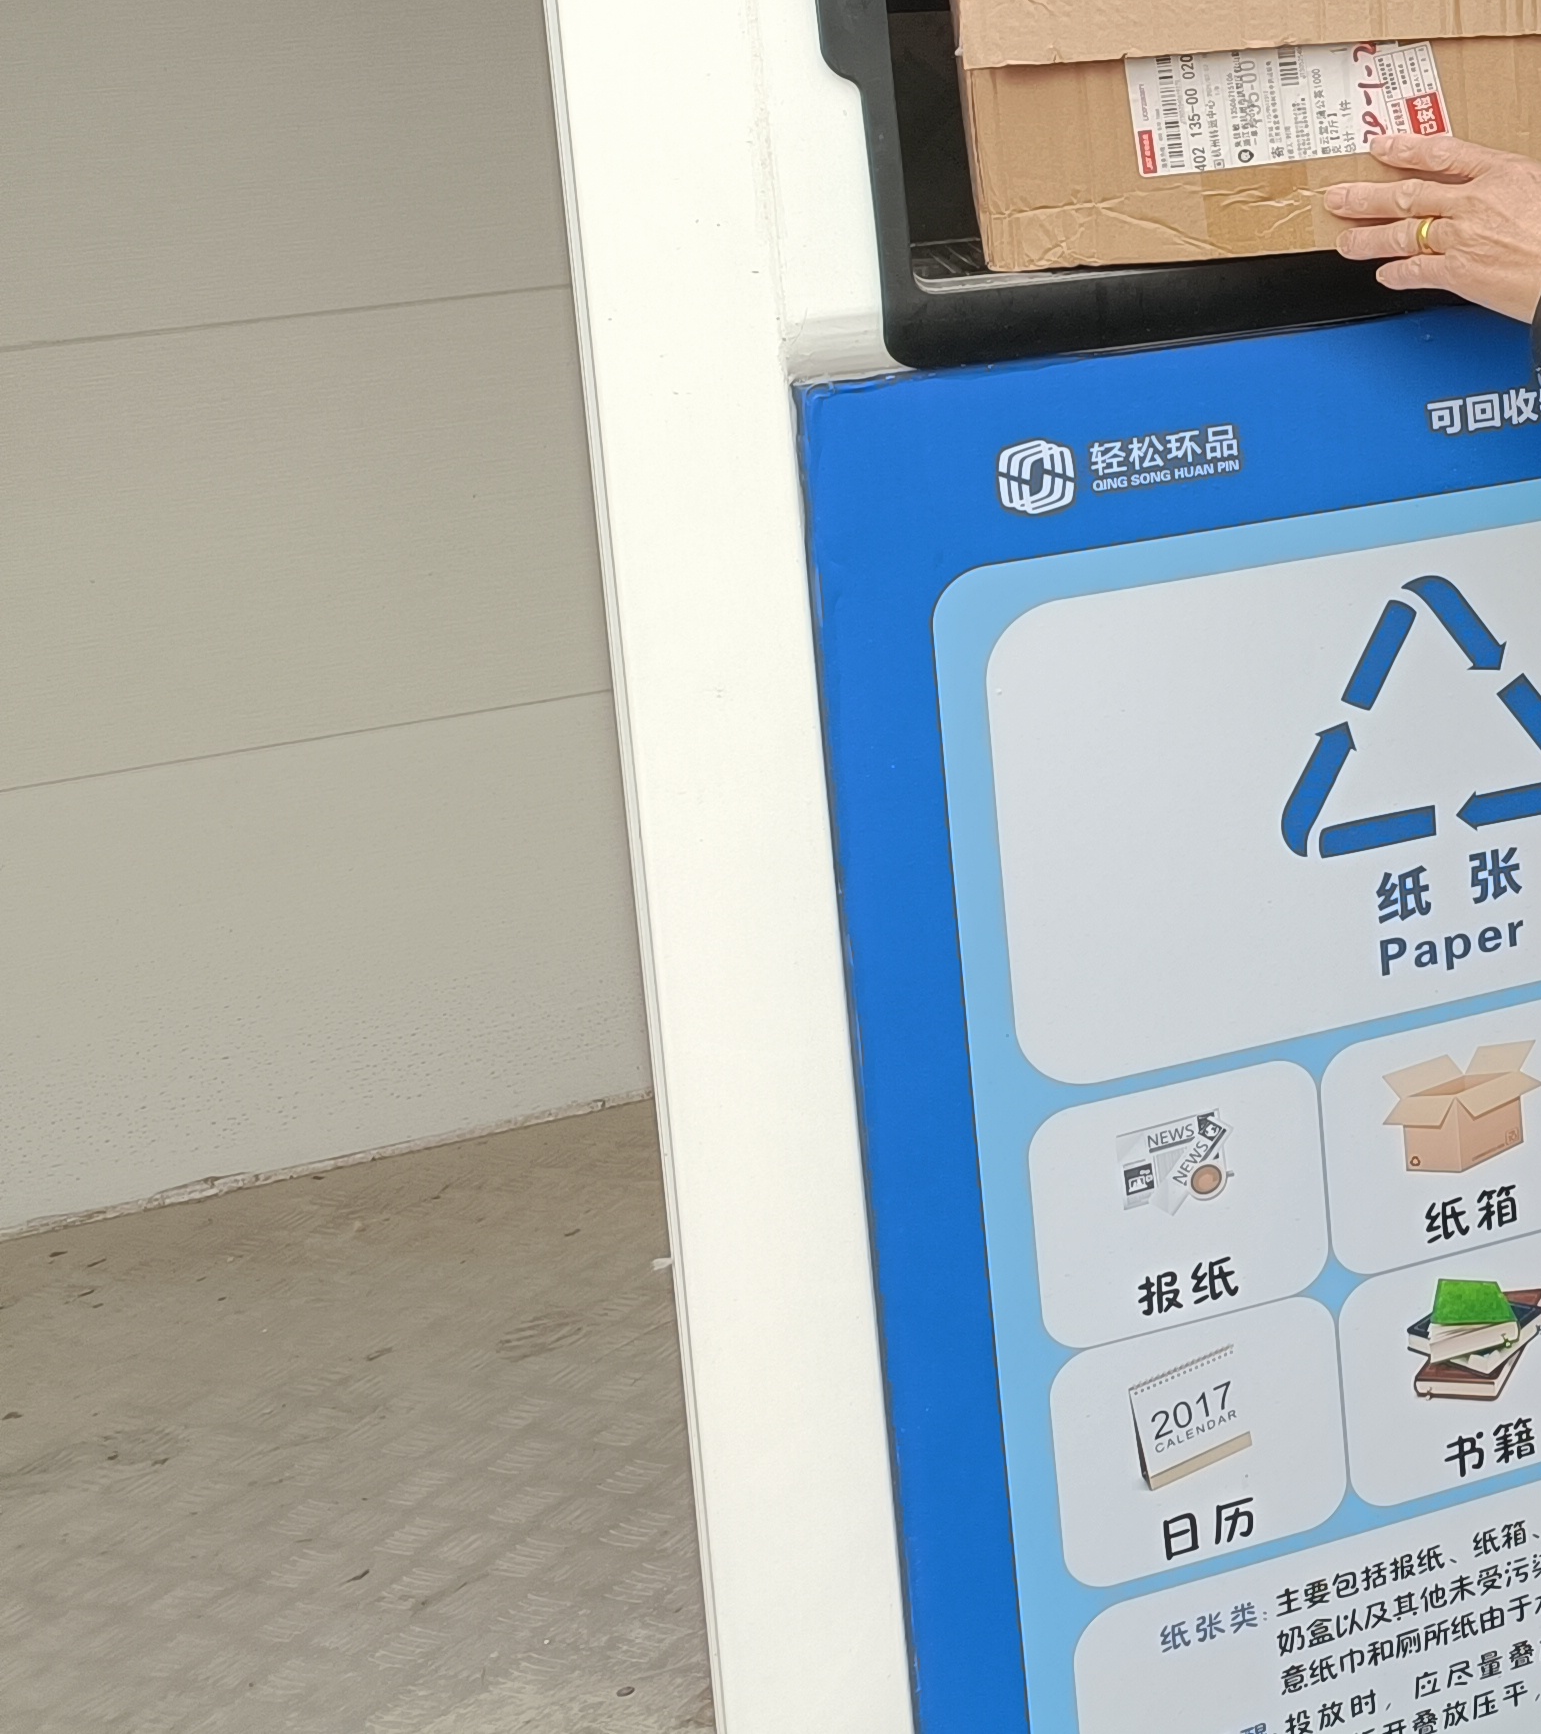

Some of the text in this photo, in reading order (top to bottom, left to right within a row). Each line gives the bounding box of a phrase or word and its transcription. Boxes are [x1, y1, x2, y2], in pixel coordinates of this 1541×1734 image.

[1413, 94, 1438, 135] 已安检
[1089, 424, 1239, 477] 轻松环品
[1092, 459, 1240, 492] QING SONG HUAN PIN
[1376, 846, 1523, 924] 纸张
[1379, 919, 1525, 976] Paper
[1147, 1123, 1195, 1148] NEWS
[1172, 1140, 1209, 1186] NEWS
[1424, 1183, 1520, 1246] 纸箱
[1138, 1255, 1240, 1317] 报纸
[1151, 1380, 1231, 1440] 2017
[1155, 1409, 1237, 1453] CALENDAR
[1445, 1417, 1538, 1479] 书籍
[1163, 1497, 1256, 1561] 日历
